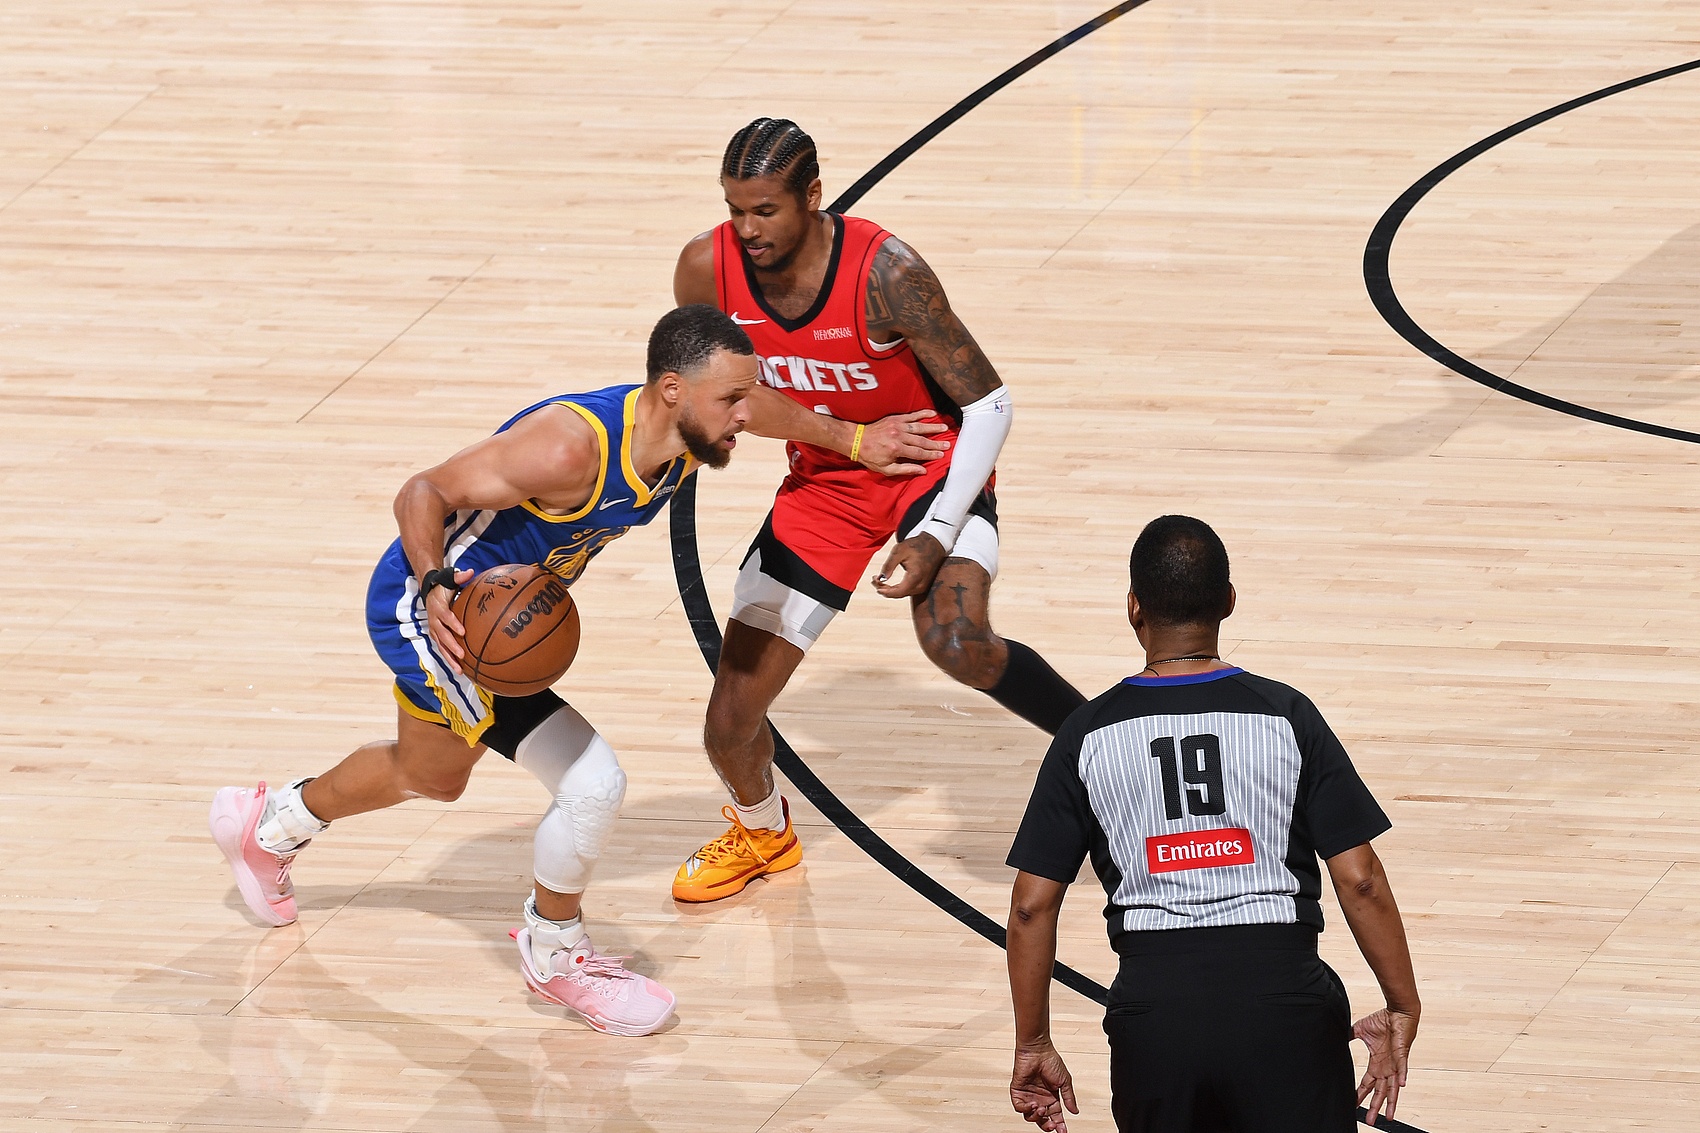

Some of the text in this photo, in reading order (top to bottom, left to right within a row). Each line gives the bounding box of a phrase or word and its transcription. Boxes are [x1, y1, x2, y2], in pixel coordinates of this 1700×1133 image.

[813, 327, 851, 335] MEMORIAL
[813, 331, 853, 340] HERMANN
[756, 354, 879, 392] OCKETS
[501, 580, 567, 639] Wilson
[1150, 733, 1226, 820] 19
[1156, 839, 1243, 862] Emirates
